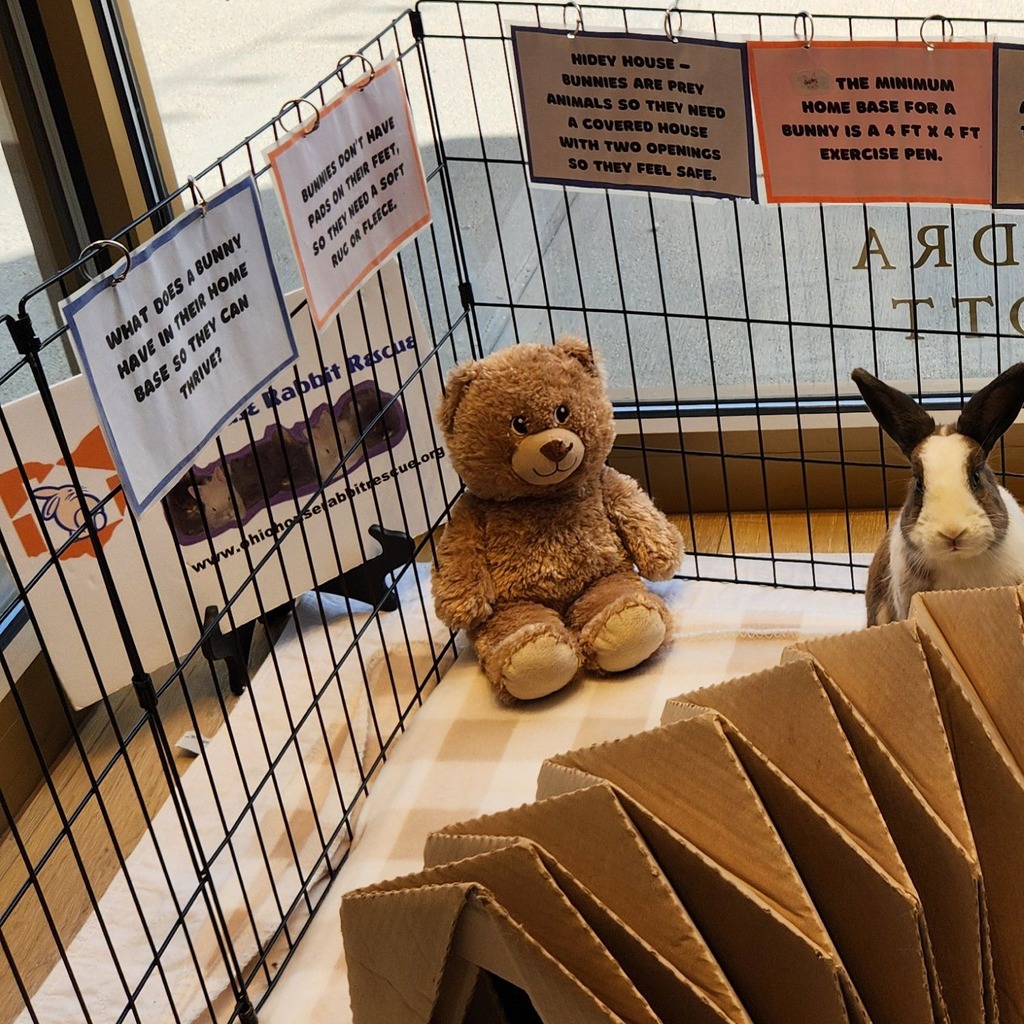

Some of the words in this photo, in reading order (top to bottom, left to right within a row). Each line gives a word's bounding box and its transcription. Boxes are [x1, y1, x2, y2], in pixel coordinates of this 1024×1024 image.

[572, 54, 616, 66] HIDEY
[622, 57, 674, 69] HOUSE
[562, 74, 627, 89] BUNNIES
[634, 78, 662, 90] ARE
[668, 81, 704, 95] PREY
[836, 77, 869, 89] THE
[876, 77, 955, 91] MINIMUM
[547, 94, 612, 110] ANIMALS
[618, 99, 640, 110] SO
[645, 100, 683, 114] THEY
[688, 104, 725, 118] NEED
[802, 101, 850, 114] HOME
[856, 101, 899, 113] BASE
[905, 101, 938, 114] FOR
[944, 103, 956, 115] A
[568, 117, 578, 128] A
[582, 118, 653, 132] COVERED
[658, 122, 708, 138] HOUSE
[782, 125, 839, 137] BUNNY
[845, 125, 861, 137] IS
[868, 125, 880, 137] A
[885, 125, 896, 137] 4
[901, 125, 921, 137] FT
[928, 126, 938, 137] X
[944, 126, 954, 138] 4
[960, 127, 980, 139] FT
[302, 161, 337, 203] BUNNIES
[338, 136, 363, 168] DON'T
[367, 117, 395, 144] HAVE
[559, 136, 599, 150] WITH
[604, 141, 641, 152] TWO
[647, 143, 721, 160] OPENINGS
[820, 148, 899, 160] EXERCISE
[905, 148, 943, 161] PEN.
[568, 158, 588, 170] SO
[593, 161, 631, 173] THEY
[637, 163, 671, 176] FEEL
[677, 166, 717, 181] SAFE.
[308, 198, 331, 228] PADS
[333, 185, 344, 204] ON
[345, 161, 370, 191] THEIR
[372, 143, 399, 168] FEET,
[313, 236, 325, 256] SO
[327, 213, 347, 240] THEY
[350, 192, 369, 219] NEED
[371, 185, 378, 198] A
[380, 163, 404, 191] SOFT
[331, 244, 348, 268] RUG
[350, 229, 361, 248] OR
[362, 199, 397, 234] FLEECE.
[106, 306, 149, 350] WHAT
[153, 277, 184, 314] DOES
[187, 269, 195, 286] A
[195, 233, 242, 275] BUNNY
[117, 339, 156, 379] HAVE
[158, 325, 174, 346] IN
[174, 293, 206, 330] THEIR
[208, 262, 248, 300] HOME
[134, 364, 170, 403] BASE
[173, 348, 187, 372] SO
[188, 317, 216, 352] THEY
[220, 295, 249, 324] CAN
[179, 347, 222, 400] THRIVE?
[262, 363, 341, 408] Rabbit
[346, 336, 416, 373] Rescue
